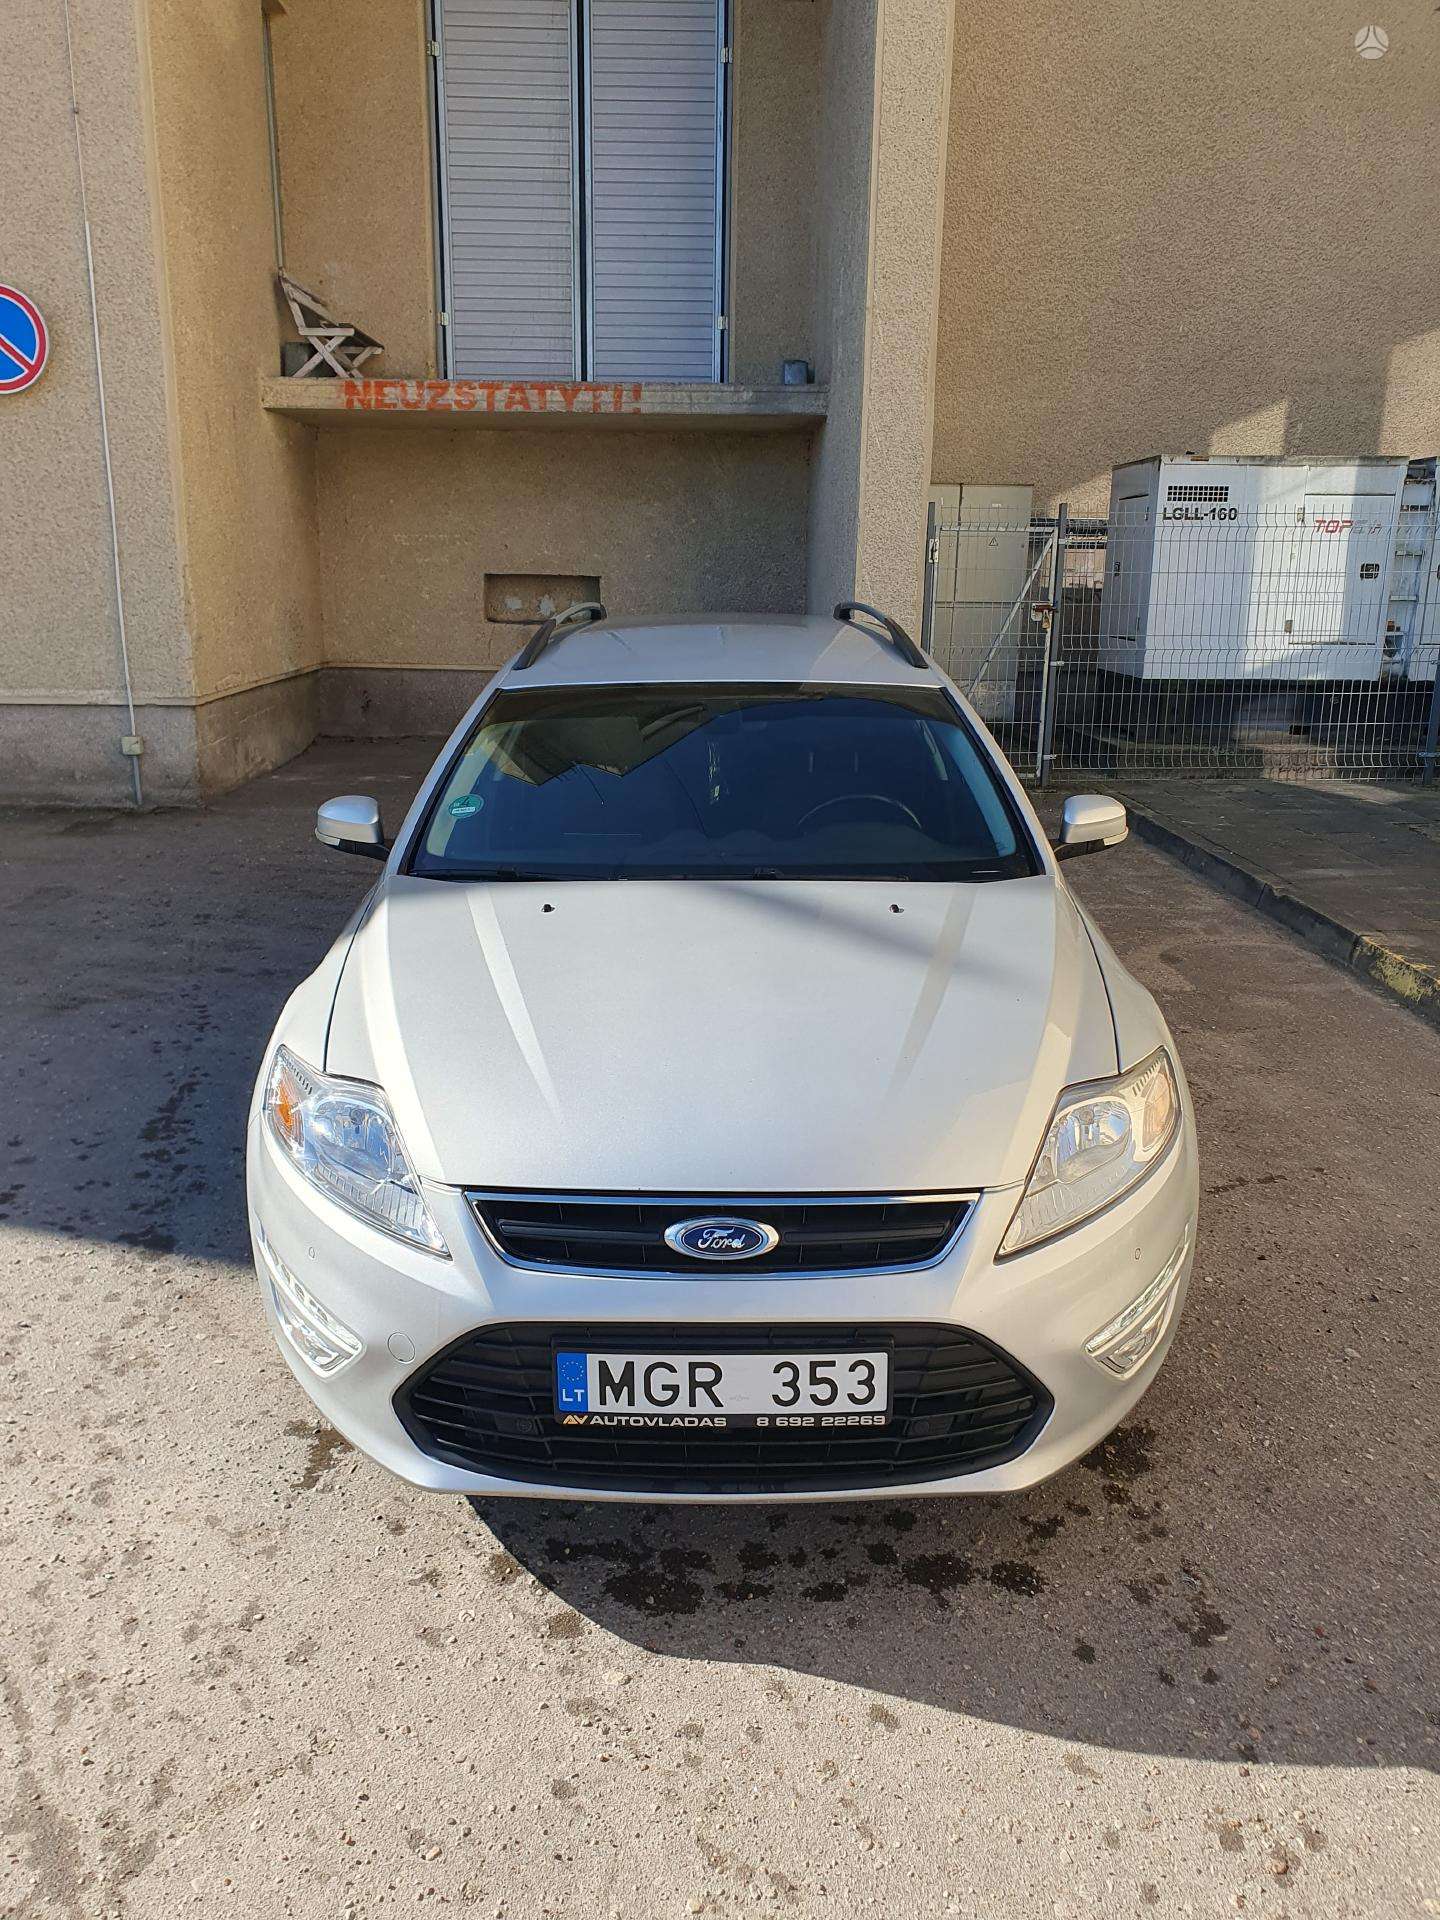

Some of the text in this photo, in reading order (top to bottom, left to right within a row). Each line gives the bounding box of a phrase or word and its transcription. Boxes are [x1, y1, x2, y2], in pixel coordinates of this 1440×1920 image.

[343, 379, 643, 414] NEUZSTATYTI!
[1162, 507, 1238, 521] LGLL-160
[697, 1227, 746, 1249] Ford
[598, 1359, 876, 1408] MGR 353
[562, 1388, 585, 1402] LT
[590, 1415, 727, 1428] AUTOVLADAS
[756, 1416, 770, 1427] 8
[775, 1416, 815, 1427] 692
[821, 1415, 886, 1427] 22269
